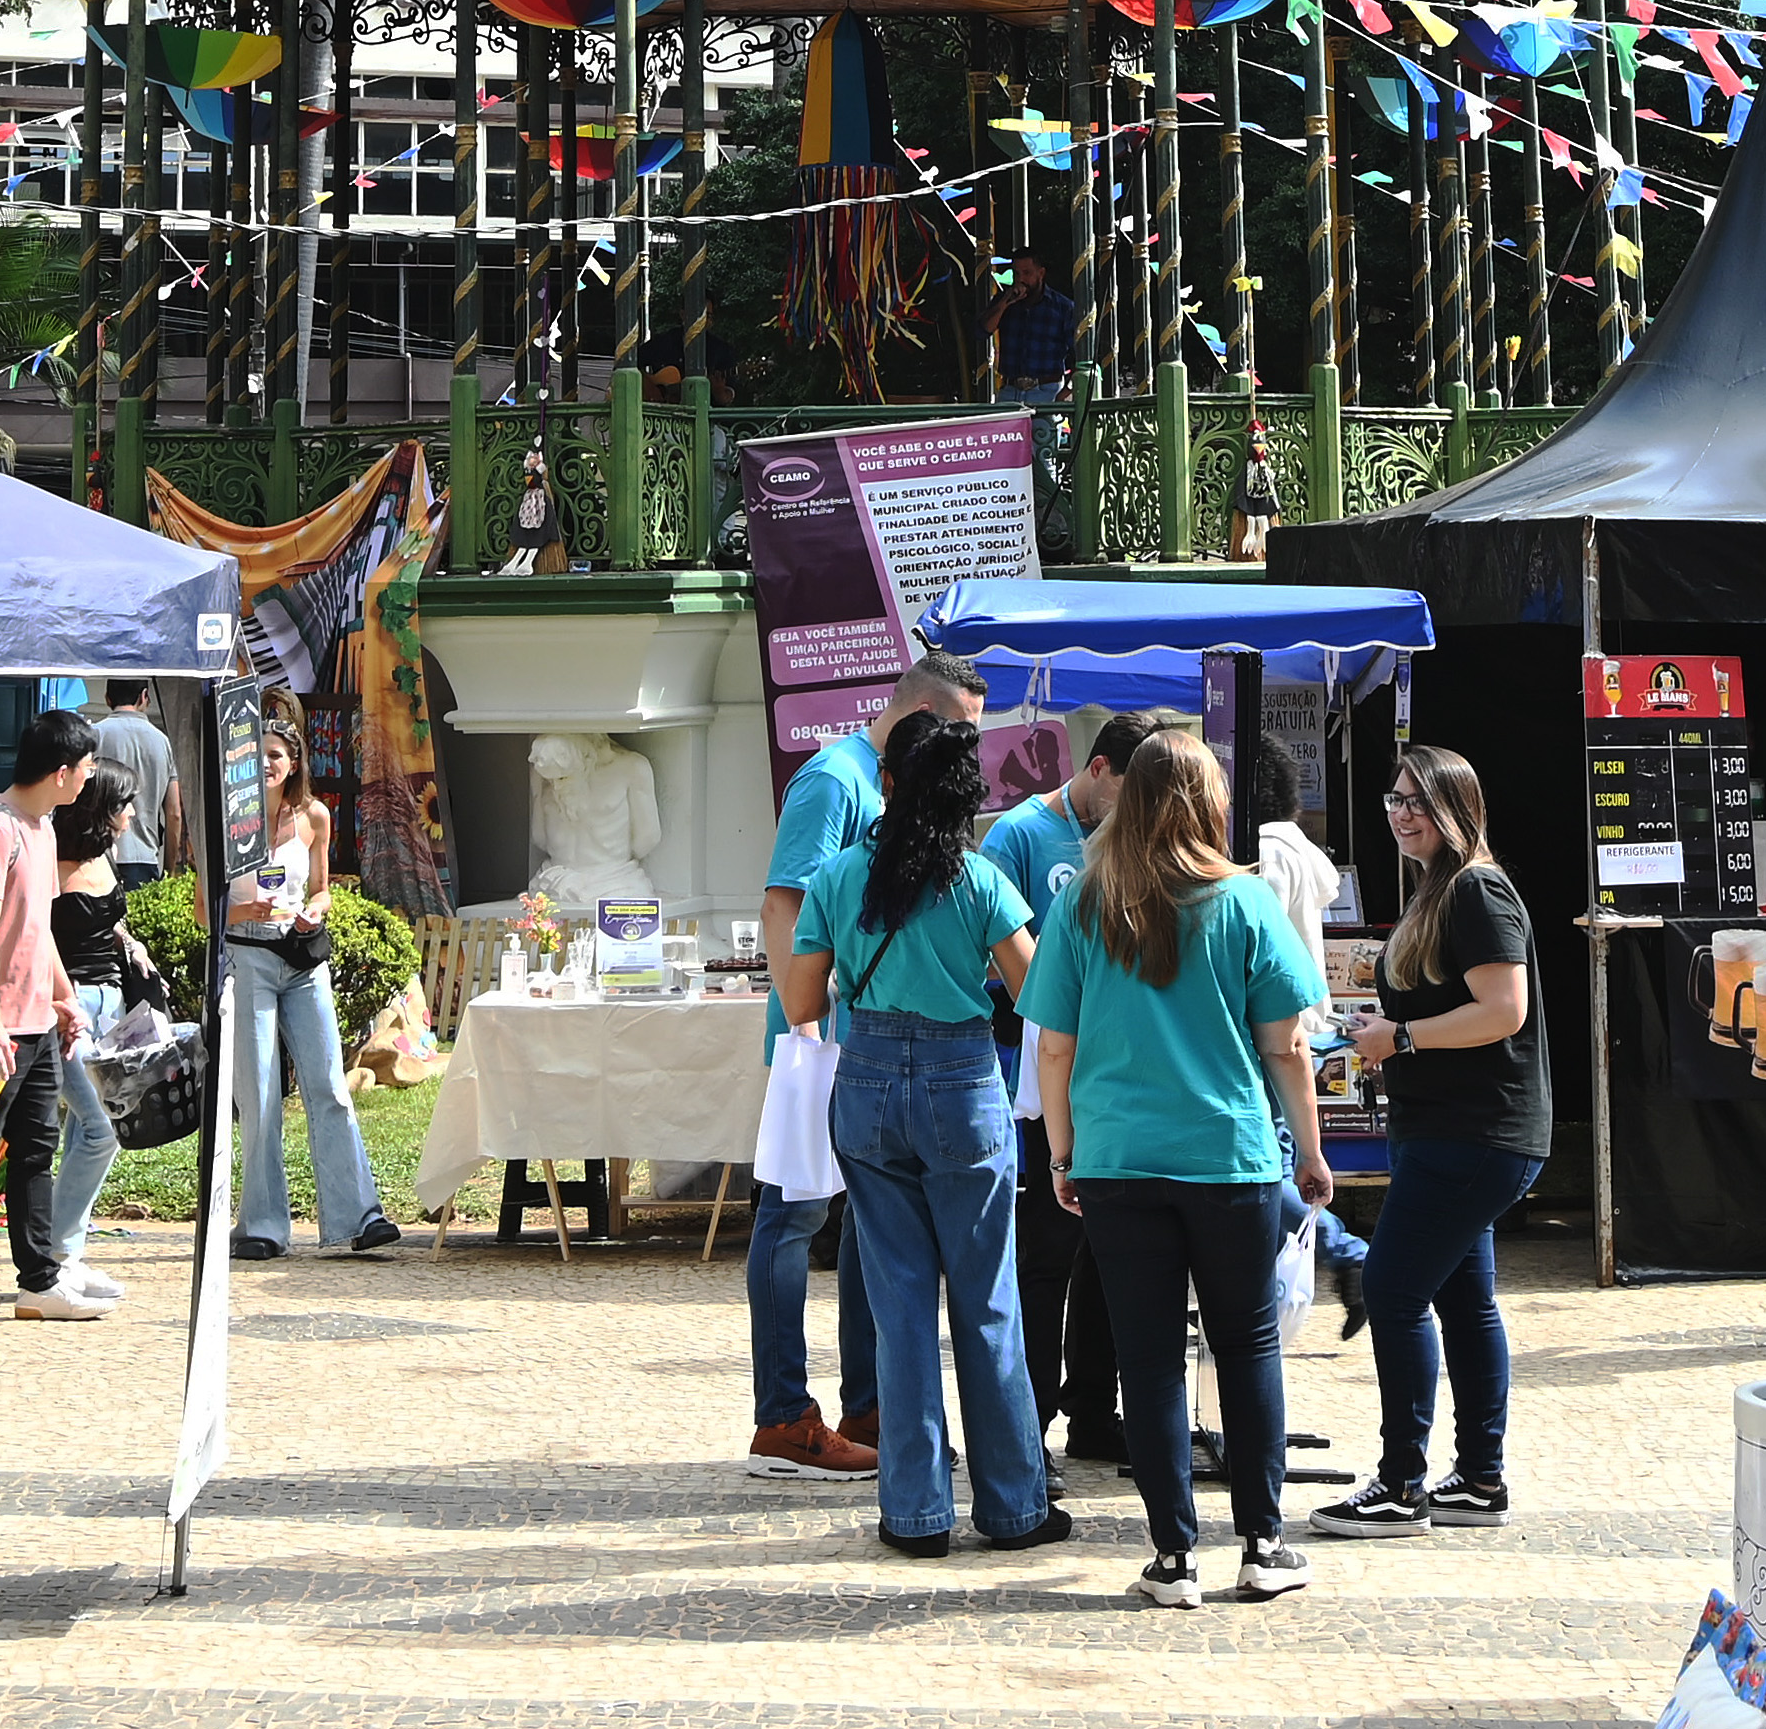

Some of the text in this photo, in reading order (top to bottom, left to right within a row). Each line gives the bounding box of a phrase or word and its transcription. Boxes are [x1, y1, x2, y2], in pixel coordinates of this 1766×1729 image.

[853, 432, 1024, 458] VOCÊ SABE O QUE É, E PARA
[858, 449, 993, 472] QUE SERVE O CEAMO?
[770, 471, 810, 483] CEAMO
[868, 480, 1009, 502] É UM SERVIÇO PÚBLICO
[771, 501, 797, 511] Centro
[779, 509, 801, 519] Apoio
[809, 507, 836, 515] Mulher
[873, 493, 1027, 517] MUNICIPAL CRIADO COM A
[878, 515, 949, 530] FINALIDADE
[952, 513, 968, 523] DE
[972, 507, 1026, 521] ACOLHER
[884, 522, 1024, 545] PRESTAR ATENDIMENTO
[889, 535, 1027, 559] PSICOLÓGICO, SOCIAL E
[894, 556, 972, 574] ORIENTAÇÃO
[975, 551, 1026, 566] JURÍDICA
[899, 564, 1027, 589] MULHER EM SITUAÇÃO
[905, 593, 921, 604] DE
[772, 622, 886, 643] SEJA VOCÊ TAMBÉM
[786, 635, 895, 656] UM(A) PARCEIRO(A)
[790, 648, 898, 669] DESTA LUTA, AJUDE
[833, 661, 902, 678] A DIVULGAR
[1647, 692, 1689, 703] LE MANS
[1261, 710, 1317, 730] GRATUITA
[790, 724, 832, 740] 0800
[1678, 732, 1703, 744] 440ML
[1593, 760, 1624, 775] PILSEN
[1595, 792, 1630, 807] ESCURO
[1596, 824, 1625, 839] VINHO
[1606, 845, 1675, 857] REFRIGERANTE
[1727, 853, 1752, 872] 6,00
[1599, 890, 1615, 905] IPA
